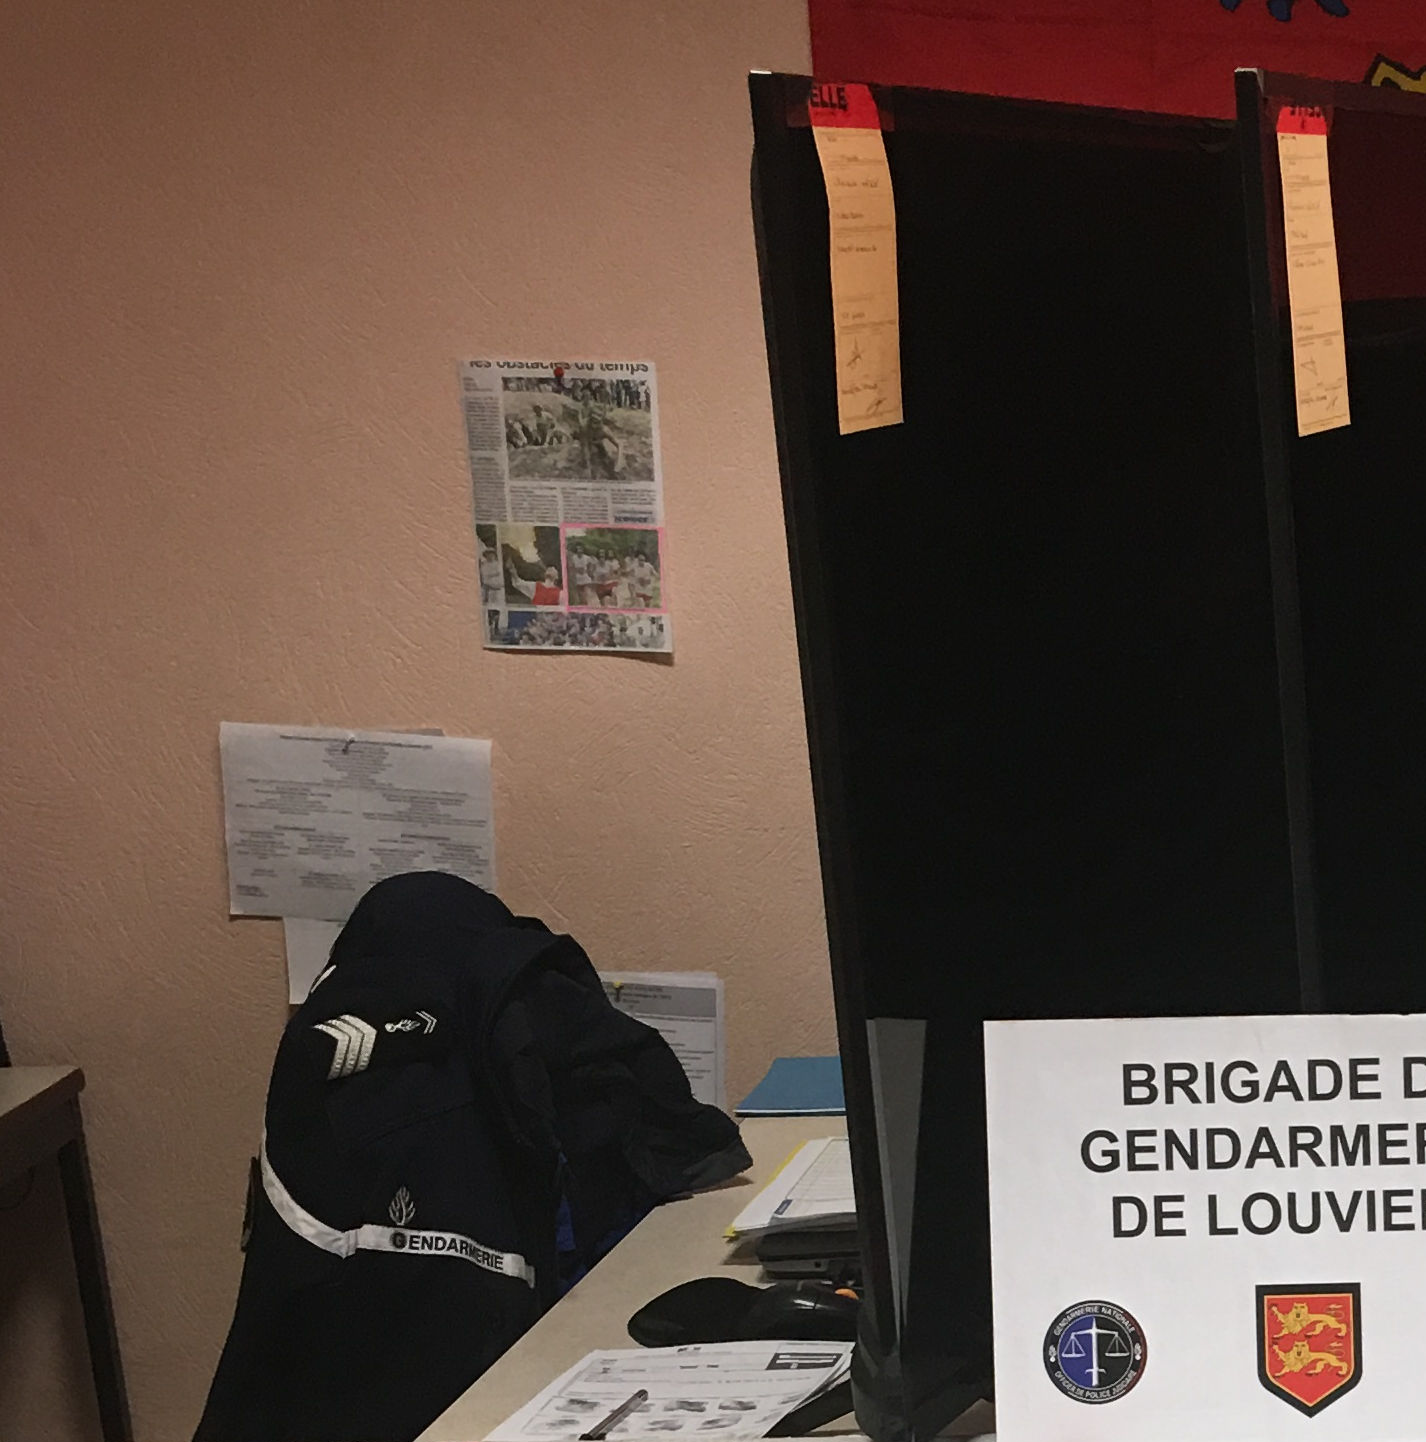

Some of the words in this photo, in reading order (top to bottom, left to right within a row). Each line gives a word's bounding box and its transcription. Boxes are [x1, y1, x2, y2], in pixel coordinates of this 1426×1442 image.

[1122, 1057, 1381, 1106] BRIGADE
[1112, 1194, 1187, 1238] DE
[391, 1232, 504, 1270] GENDARMERIE
[1085, 1390, 1111, 1399] POLICE
